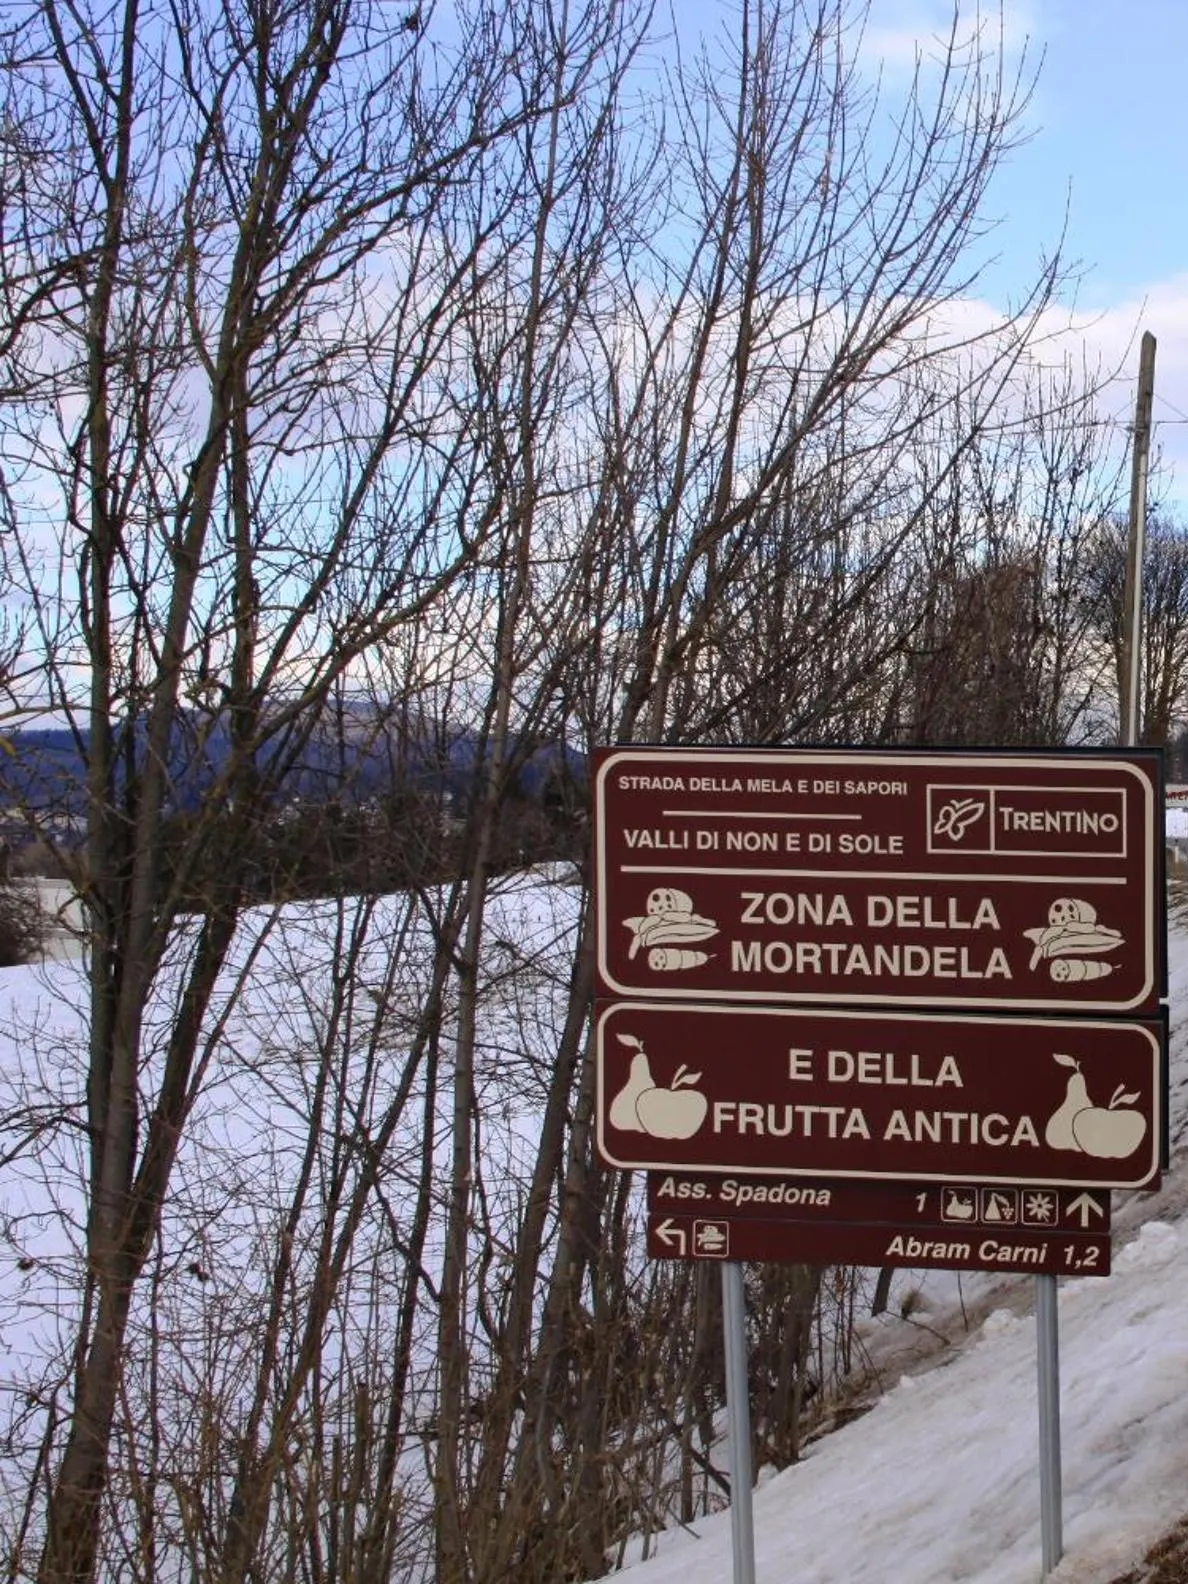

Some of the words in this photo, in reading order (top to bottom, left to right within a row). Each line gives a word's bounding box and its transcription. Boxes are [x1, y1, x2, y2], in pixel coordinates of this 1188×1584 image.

[618, 776, 685, 791] STRADA
[689, 777, 743, 792] DELLA
[747, 778, 793, 793] MELA
[798, 779, 808, 793] E
[813, 780, 840, 794] DEI
[844, 780, 908, 795] SAPORI
[623, 829, 689, 850] VALLI
[696, 830, 719, 850] DI
[726, 831, 778, 851] NON
[786, 833, 801, 852] E
[808, 834, 831, 853] DI
[838, 834, 904, 855] SOLE
[740, 892, 853, 927] ZONA
[866, 896, 1000, 930] DELLA
[731, 940, 1012, 979] MORTANDELA
[789, 1048, 813, 1082] E
[827, 1050, 963, 1088] DELLA
[713, 1101, 871, 1140] FRUTTA
[883, 1107, 1040, 1148] ANTICA
[657, 1176, 712, 1200] Ass.
[719, 1180, 832, 1208] Spadona
[915, 1192, 928, 1213] 1
[886, 1235, 971, 1261] Abram
[978, 1240, 1048, 1265] Carni
[1063, 1245, 1100, 1269] 1,2
